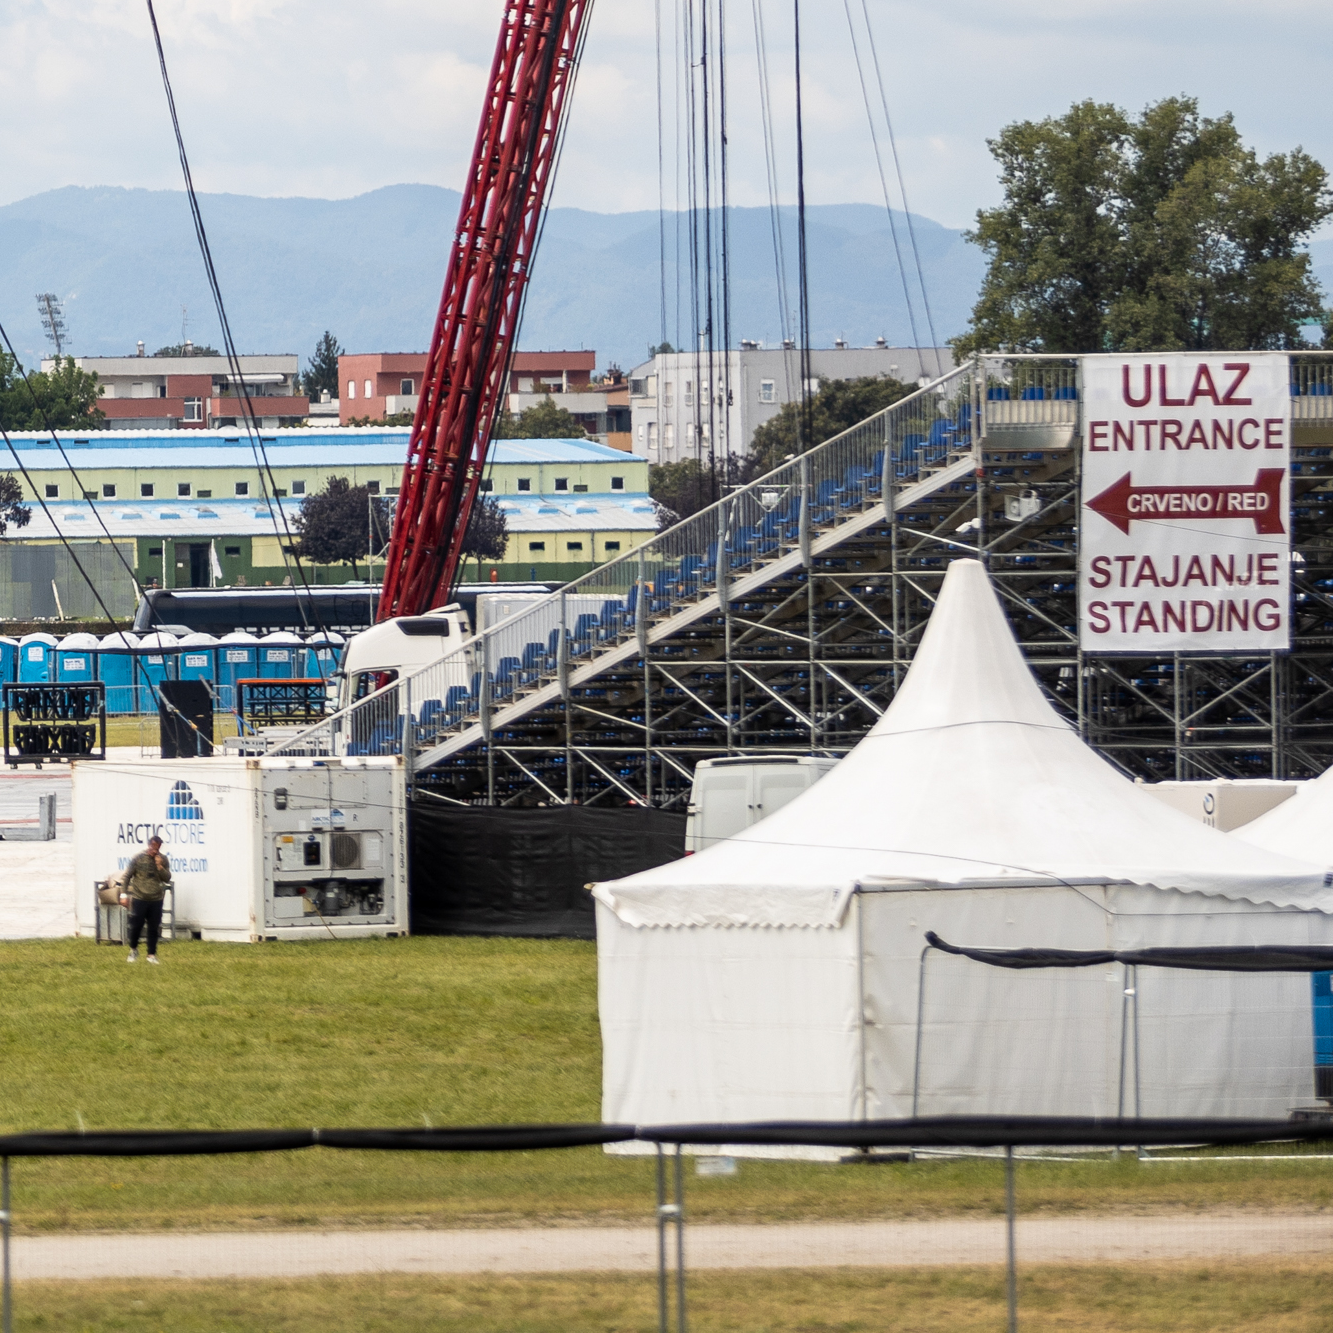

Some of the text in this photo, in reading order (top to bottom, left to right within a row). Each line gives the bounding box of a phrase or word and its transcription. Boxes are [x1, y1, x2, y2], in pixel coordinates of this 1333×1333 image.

[1121, 362, 1253, 408] ULAZ
[1088, 418, 1284, 452] ENTRANCE
[1126, 492, 1270, 513] CRVENO / RED
[1088, 553, 1280, 589] STAJANJE
[1088, 598, 1281, 634] STANDING
